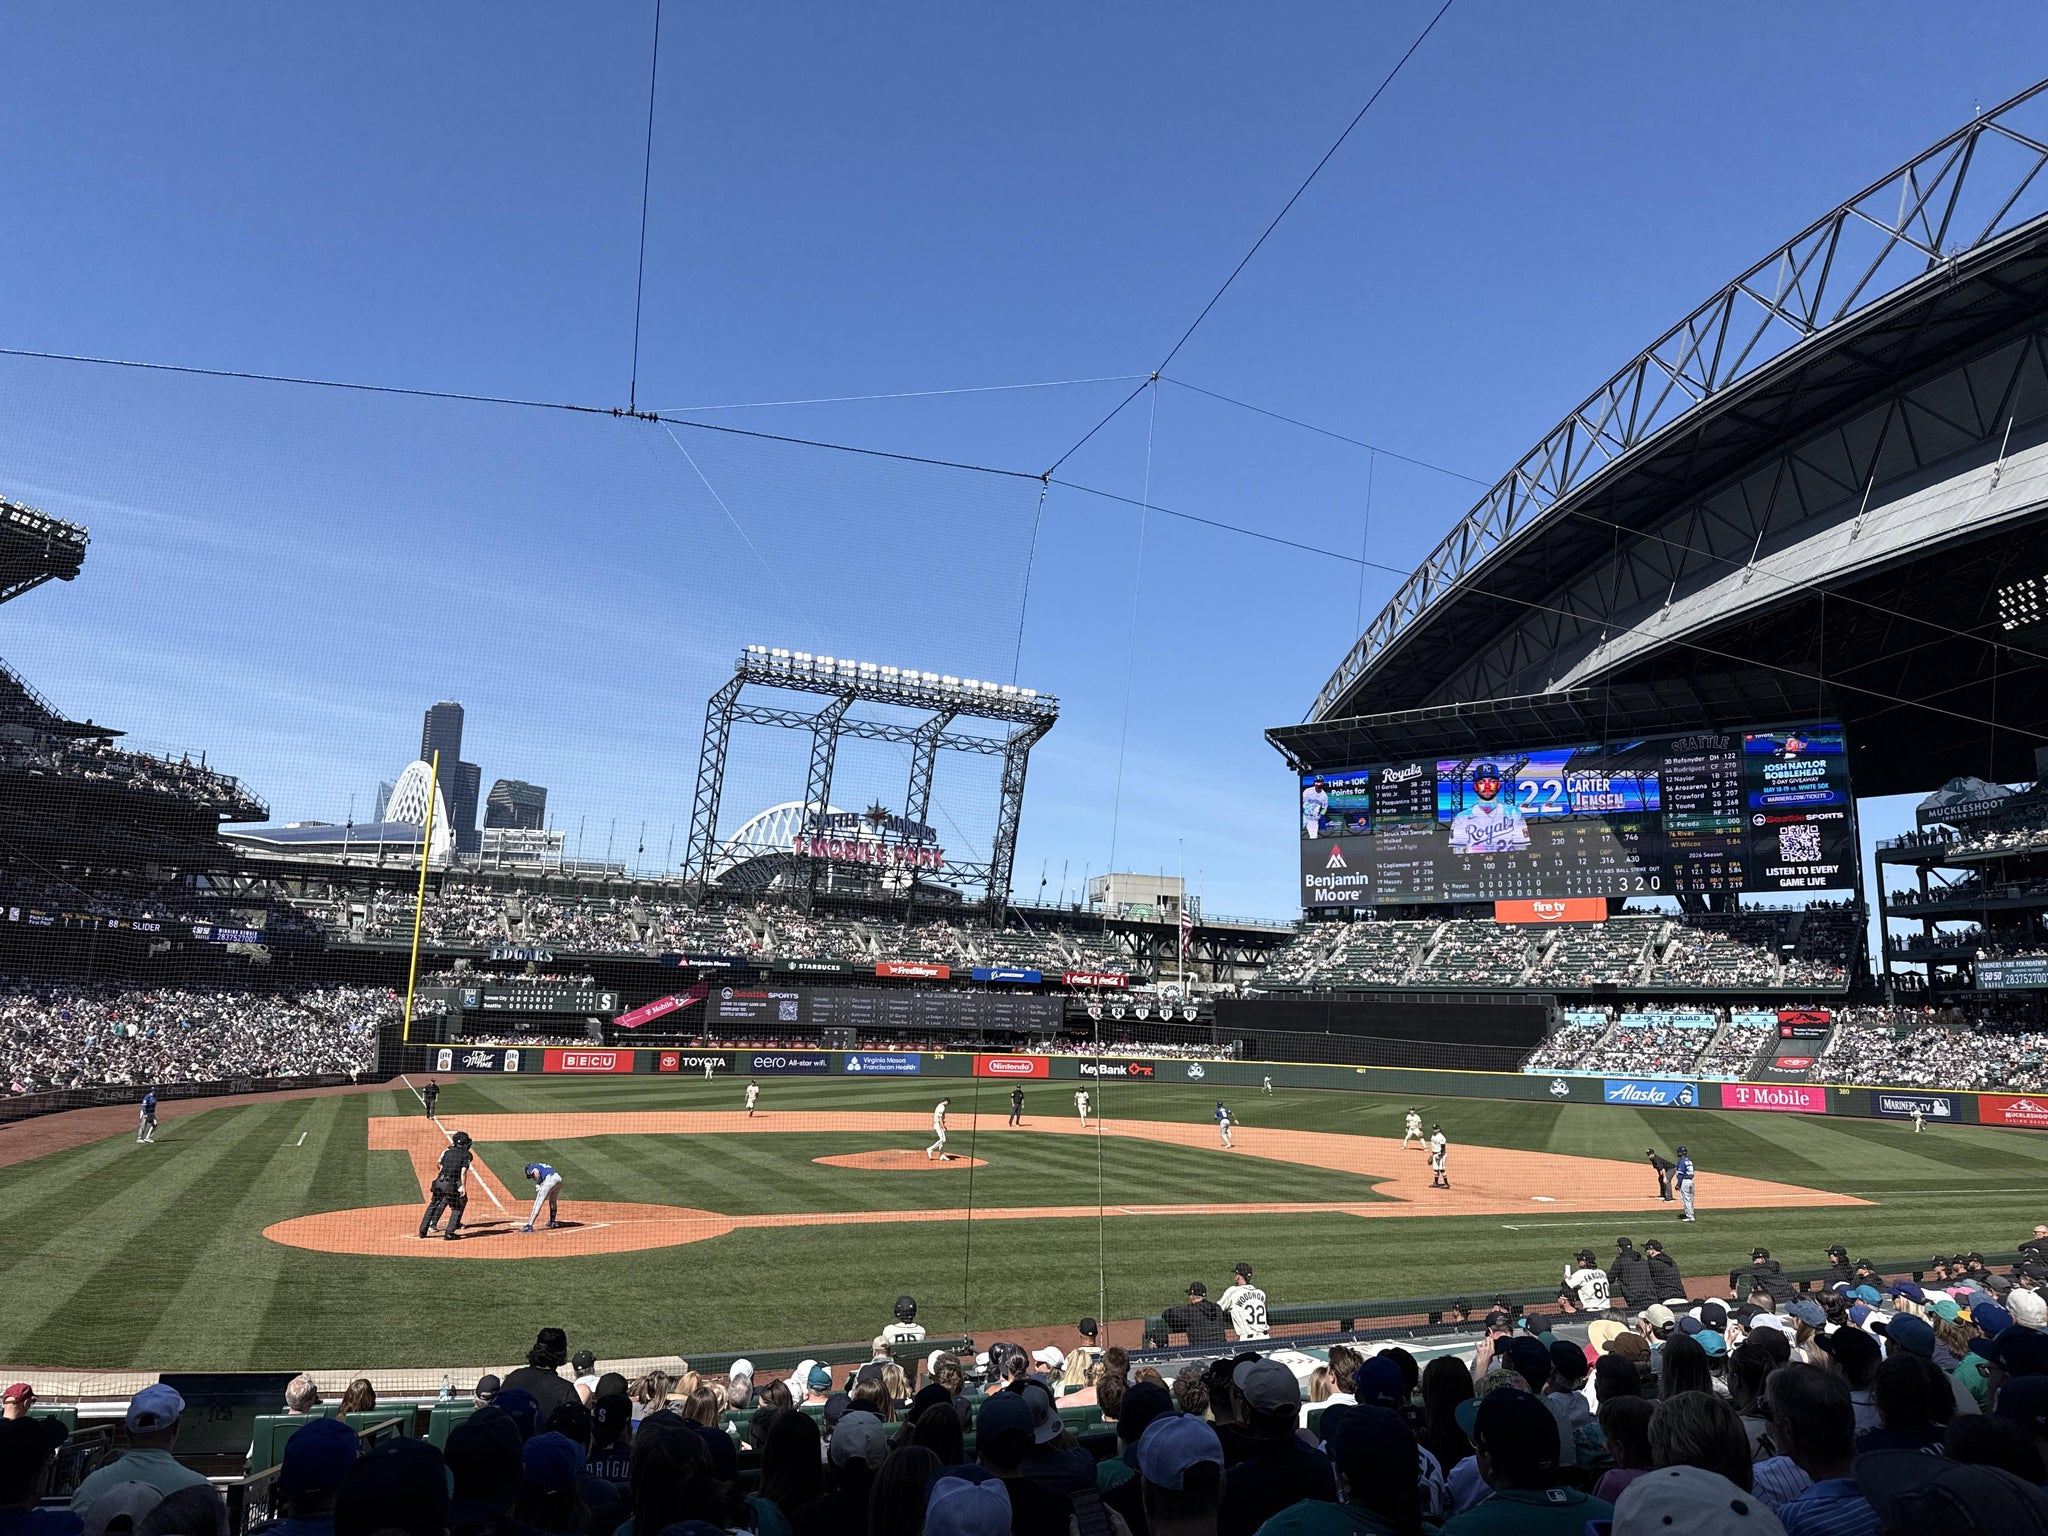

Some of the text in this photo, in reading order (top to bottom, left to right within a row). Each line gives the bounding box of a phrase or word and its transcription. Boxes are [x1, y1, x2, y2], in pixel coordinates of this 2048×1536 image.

[1671, 735, 1730, 752] SEATTLE
[1762, 760, 1827, 773] JOSH NAYLOR
[1382, 763, 1423, 784] Royals
[1673, 775, 1696, 783] Naylor
[1764, 768, 1826, 780] BOBBLEHEAD
[1332, 778, 1366, 788] HR 10K
[1566, 777, 1611, 793] CARTER
[1674, 783, 1708, 791] Arozarena
[1331, 787, 1366, 797] Points for
[1518, 779, 1563, 813] 22
[1674, 792, 1705, 800] Crawford
[1572, 792, 1624, 811] JENSEN
[1675, 803, 1696, 811] Young
[1928, 798, 2005, 818] MUCKLESHOOT
[1676, 820, 1700, 828] Pereda
[1766, 812, 1844, 823] Seattle SPORTS
[808, 812, 937, 842] SEATTLE MARINERS
[1466, 816, 1514, 844] Royals
[792, 835, 945, 868] T-MOBILE PARK
[1462, 863, 1471, 871] 32
[1765, 865, 1839, 876] LISTEN TO EVERY
[1305, 871, 1369, 889] Benjamin
[1619, 876, 1661, 891] 3 2 0
[1779, 877, 1827, 887] GAME LIVE
[1314, 888, 1361, 902] Moore
[1532, 901, 1566, 912] fire tv
[108, 919, 119, 928] 88
[132, 921, 161, 932] SLIDER
[492, 947, 554, 962] EDGARS
[798, 963, 841, 971] STARBUCKS
[2015, 959, 2047, 968] FOUNDATION
[601, 993, 612, 1010] S
[652, 1001, 674, 1014] Mobile
[462, 1054, 495, 1068] Miller
[683, 1056, 726, 1067] TOYOTA
[754, 1056, 786, 1068] eero
[788, 1059, 813, 1067] All-star
[863, 1056, 886, 1064] Virginia
[993, 1061, 1031, 1071] Nintendo
[863, 1063, 916, 1071] Franciscan Health
[1080, 1063, 1127, 1077] KeyBank
[105, 1090, 134, 1099] LEXUS
[1608, 1083, 1667, 1103] Alaska
[1753, 1090, 1810, 1106] Mobile
[1593, 1282, 1610, 1299] 80
[1245, 1304, 1266, 1325] 32
[598, 1408, 607, 1423] S
